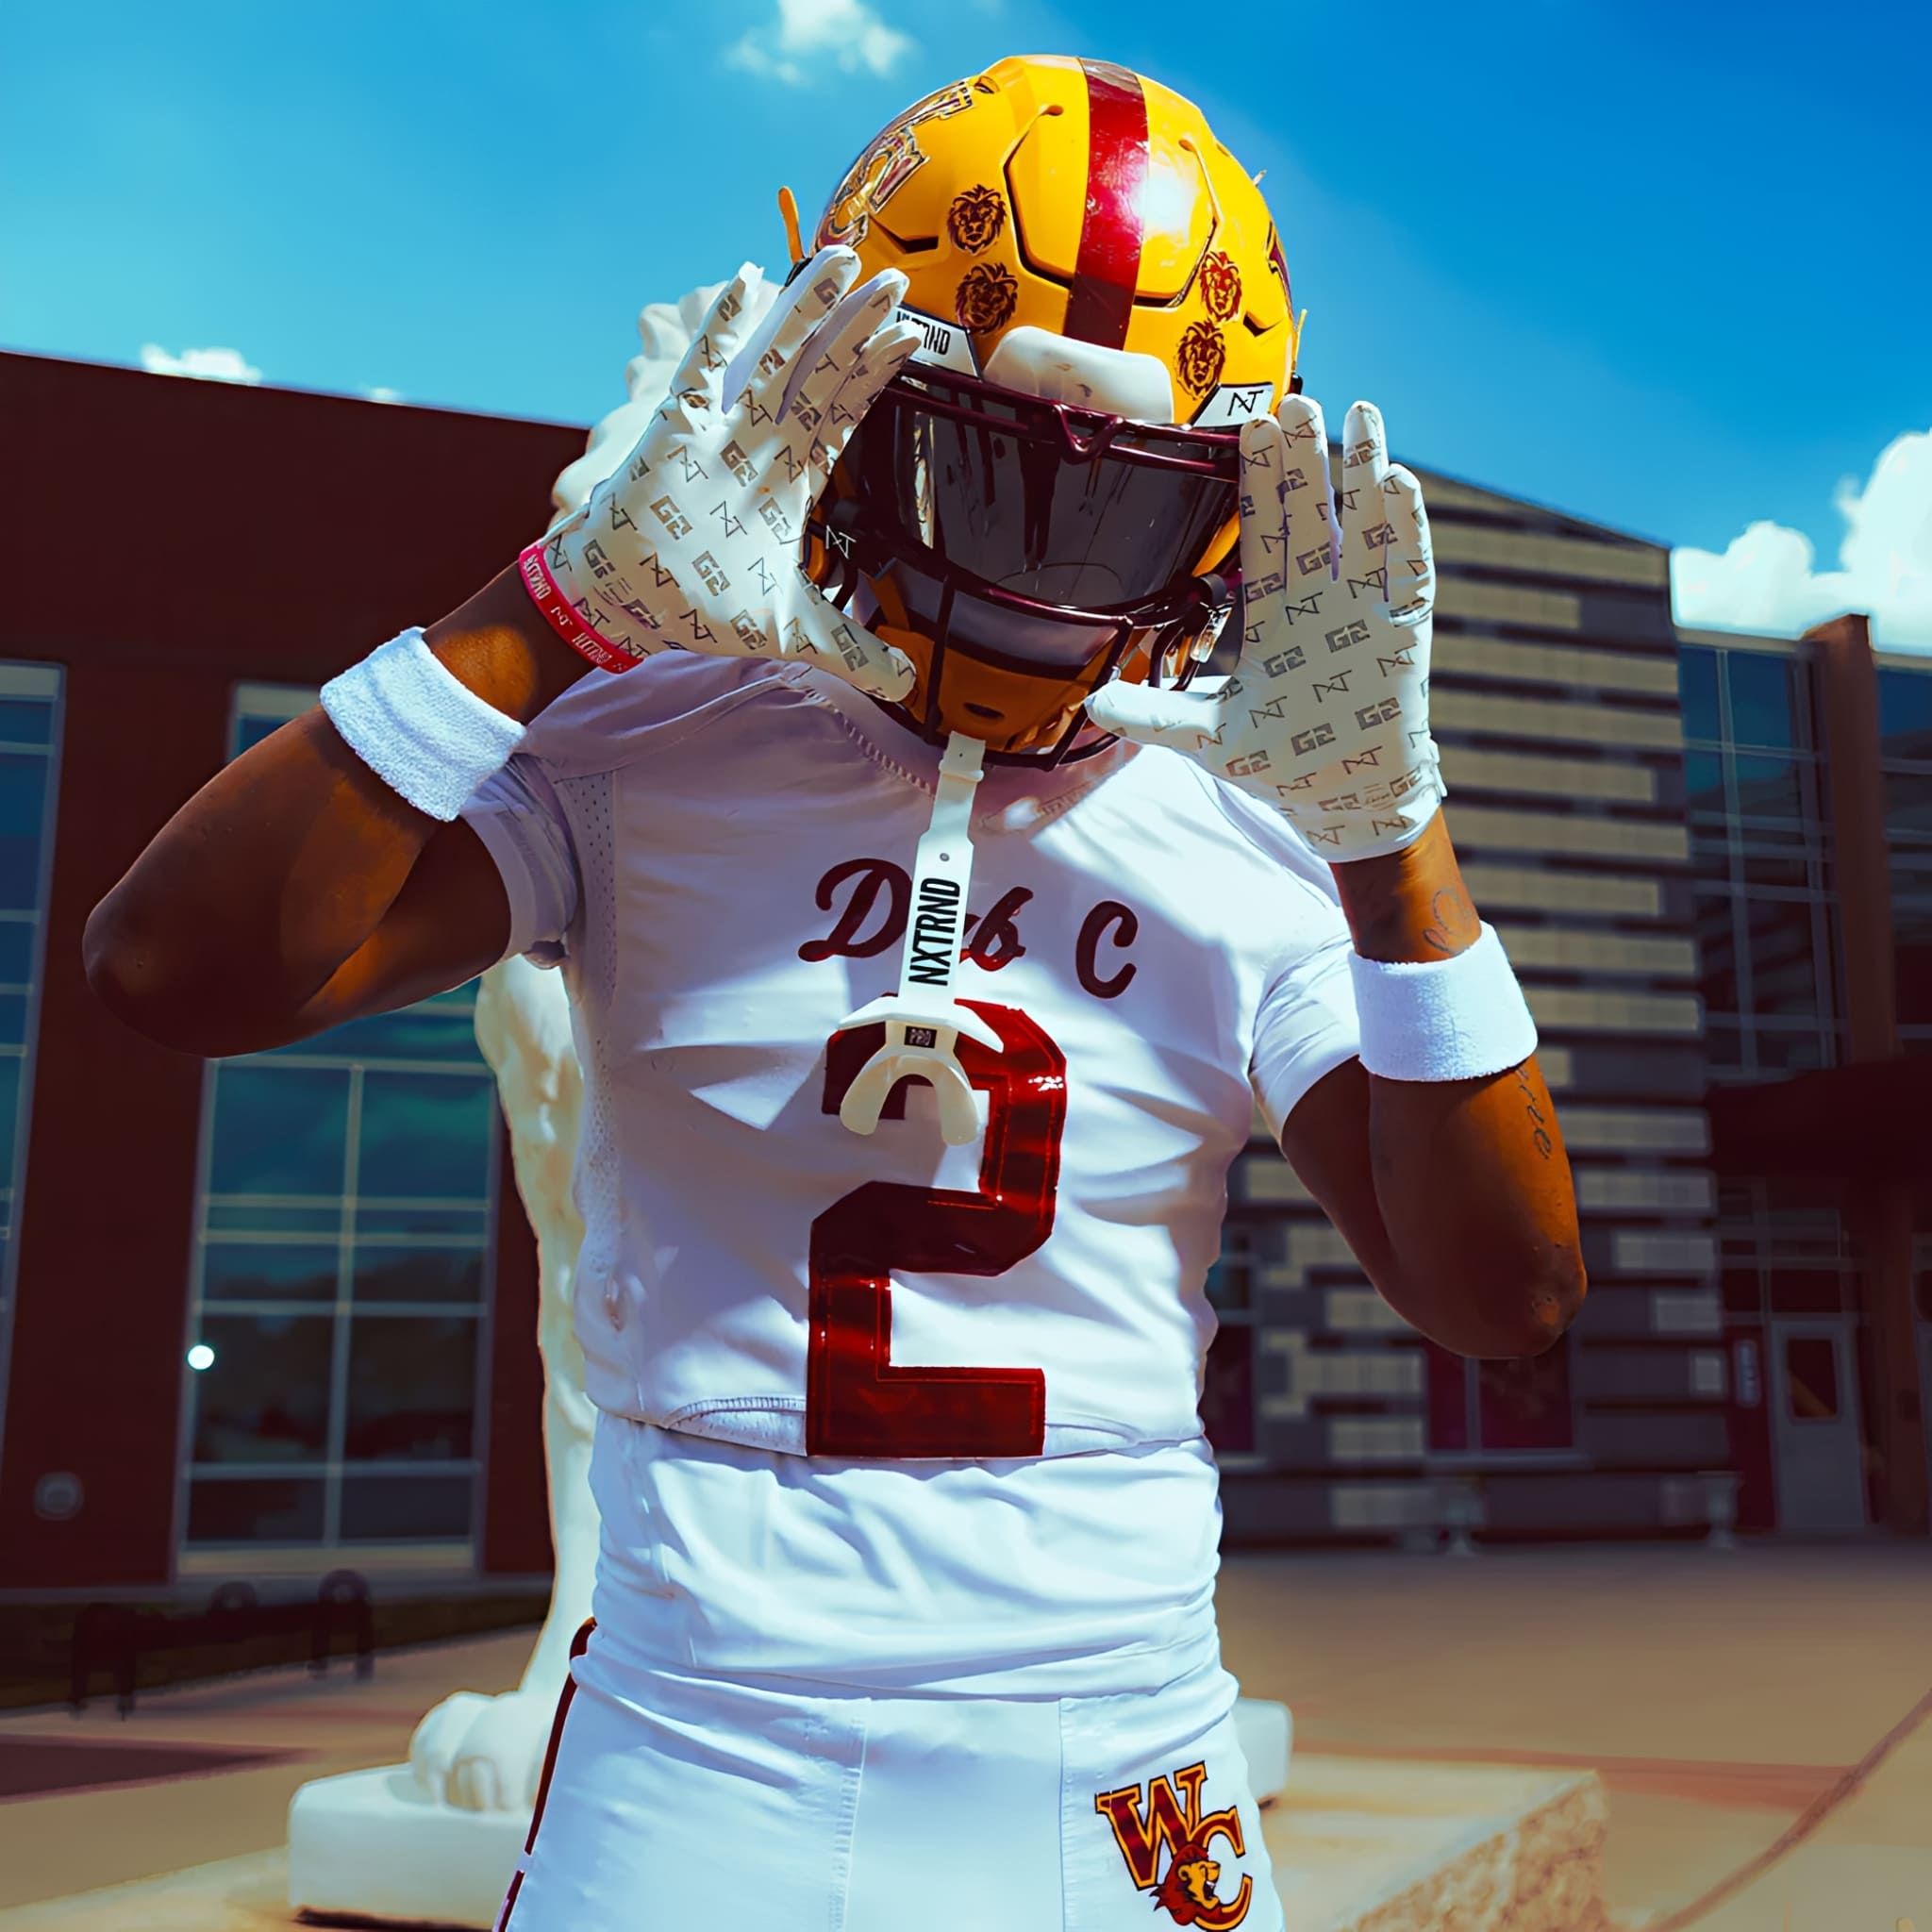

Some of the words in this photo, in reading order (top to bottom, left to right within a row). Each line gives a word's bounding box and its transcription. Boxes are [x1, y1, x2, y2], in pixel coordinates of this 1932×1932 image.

[797, 858, 1034, 972] Db
[1074, 900, 1139, 999] C
[908, 877, 961, 987] NXTRND
[806, 992, 1068, 1458] 2
[1094, 1759, 1253, 1932] WC
